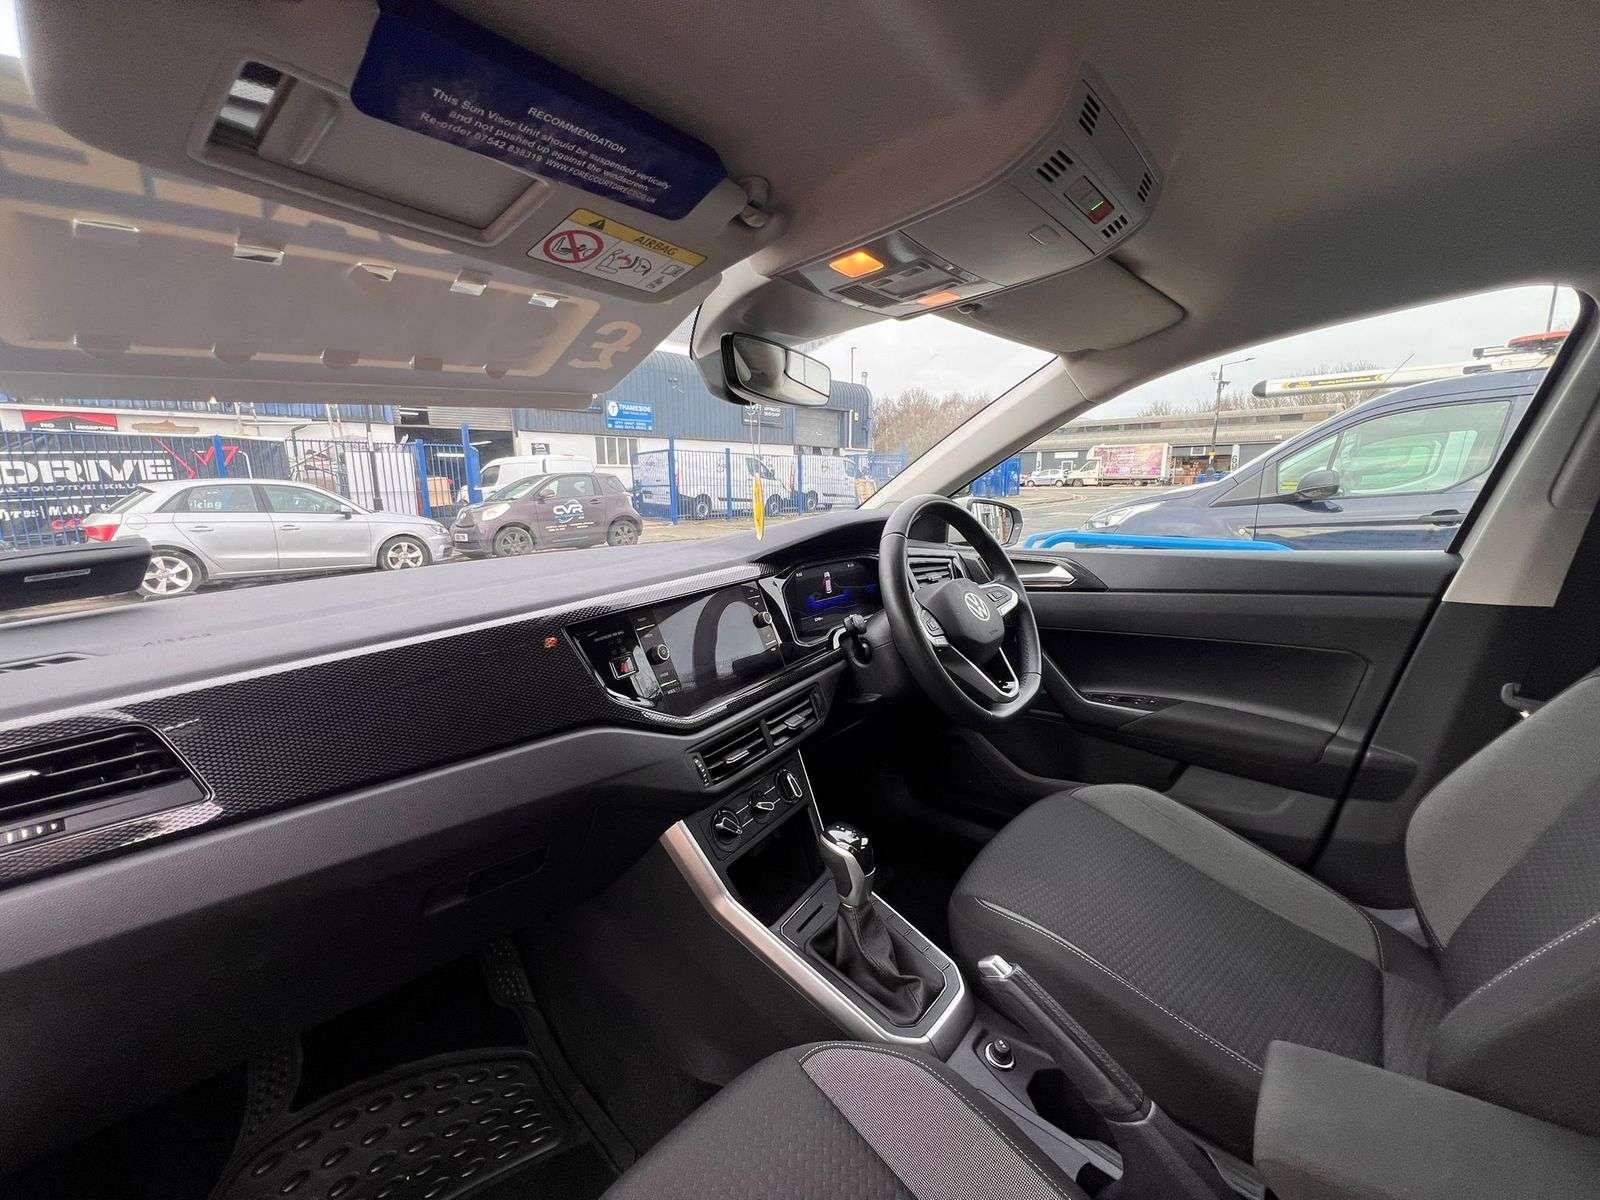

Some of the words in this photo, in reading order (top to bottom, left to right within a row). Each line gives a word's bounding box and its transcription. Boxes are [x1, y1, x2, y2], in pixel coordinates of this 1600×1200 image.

[432, 87, 458, 106] This
[461, 100, 485, 116] Sun
[488, 110, 516, 127] Visor
[519, 122, 541, 139] Unit
[541, 133, 574, 152] should
[575, 146, 588, 157] be
[589, 152, 636, 176] suspended
[448, 110, 474, 125] and
[474, 120, 494, 133] not
[495, 128, 536, 149] pushed
[537, 142, 550, 155] up
[552, 150, 587, 168] against
[588, 161, 602, 175] the
[527, 106, 627, 154] RECOMMENDATION
[634, 234, 680, 257] AIRBAG
[553, 503, 584, 515] CVR
